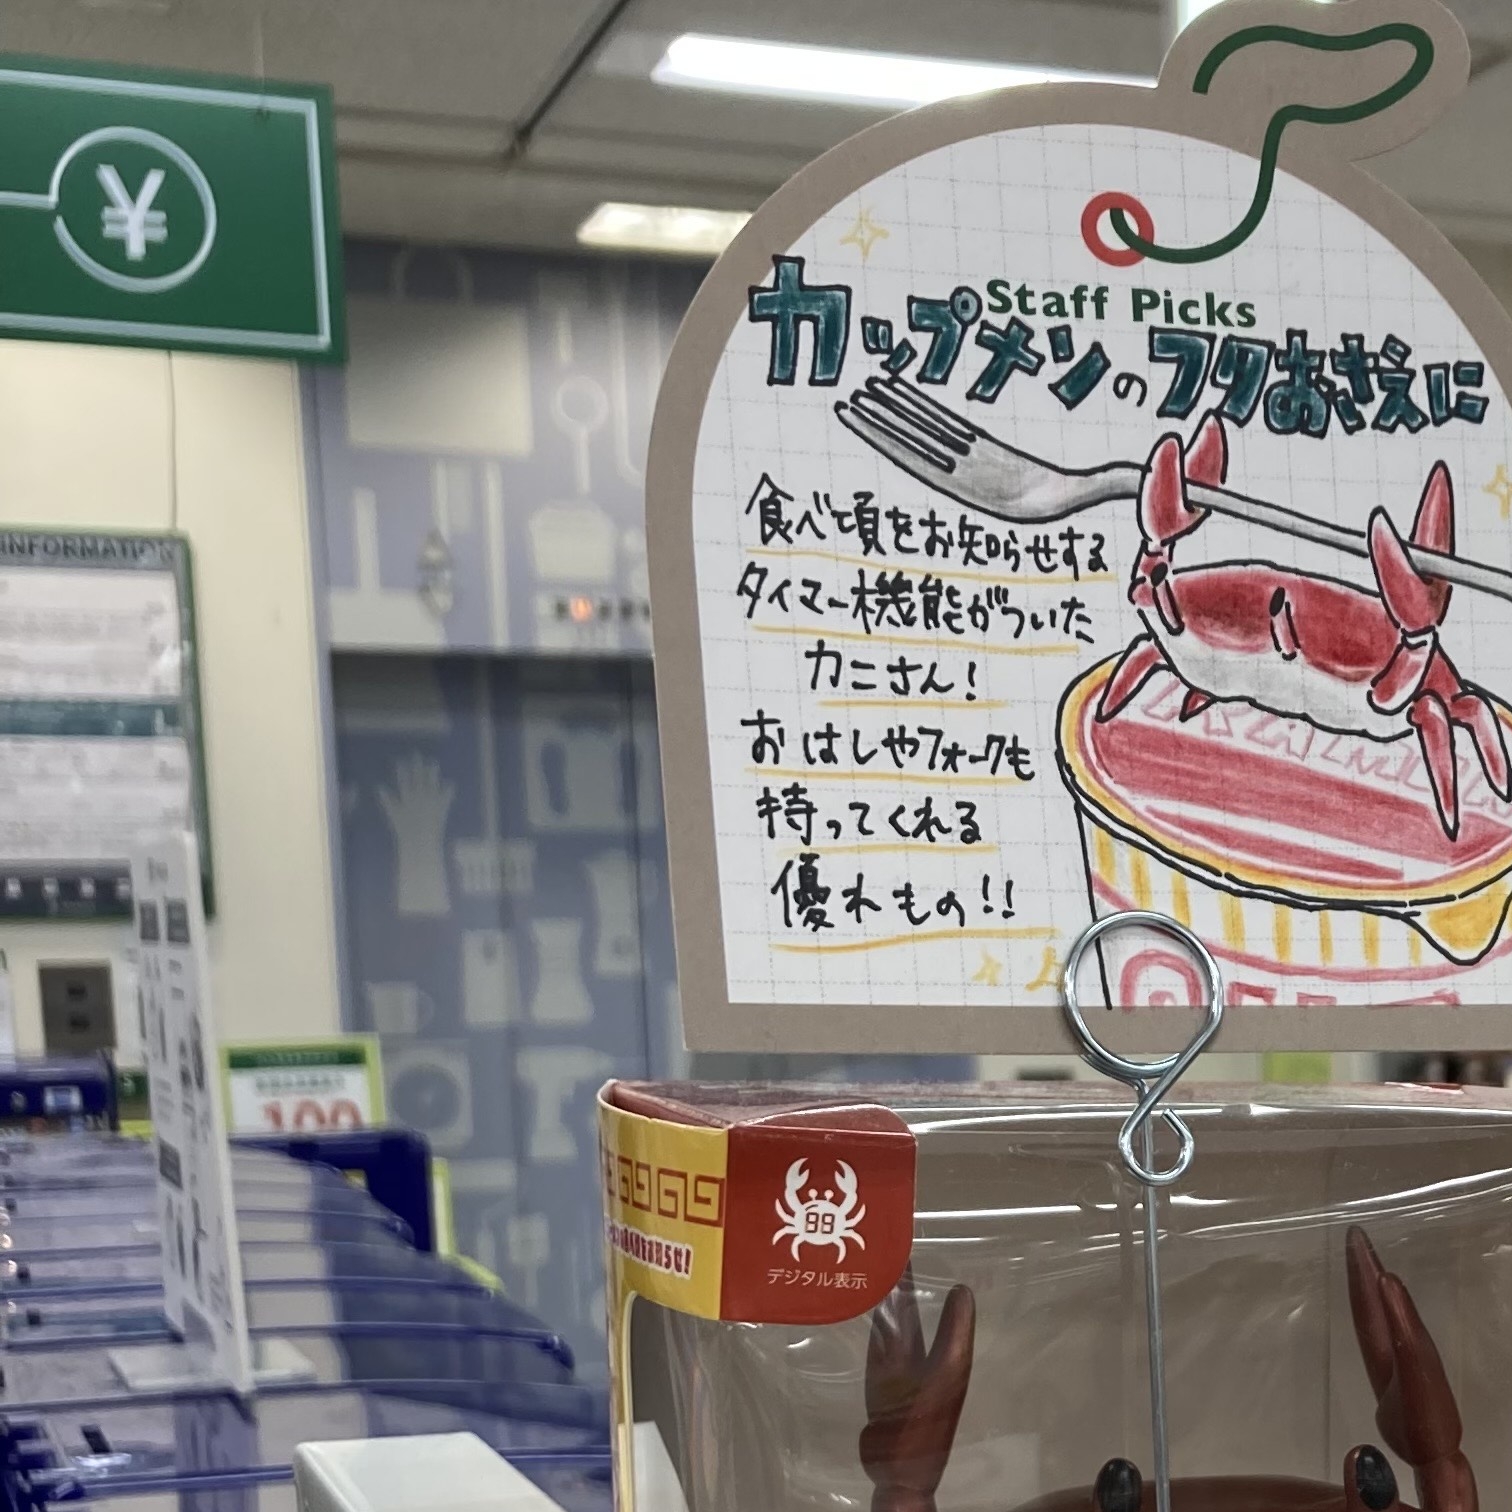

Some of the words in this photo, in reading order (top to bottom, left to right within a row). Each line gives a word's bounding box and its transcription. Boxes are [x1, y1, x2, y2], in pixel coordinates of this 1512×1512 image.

[986, 279, 1109, 320] Staff
[1132, 287, 1257, 328] Picks
[749, 255, 1490, 438] カップメンのフタおさえに
[745, 472, 1109, 581] 食べ頃をお知らせする
[736, 560, 1095, 644] タイマー機能がついた
[804, 640, 977, 701] カニさん!
[740, 709, 1036, 781] おはしやフォークも
[756, 781, 983, 846] 持ってくれる
[770, 852, 1015, 932] 優れもの!!
[767, 1268, 868, 1291] デジタル表示
